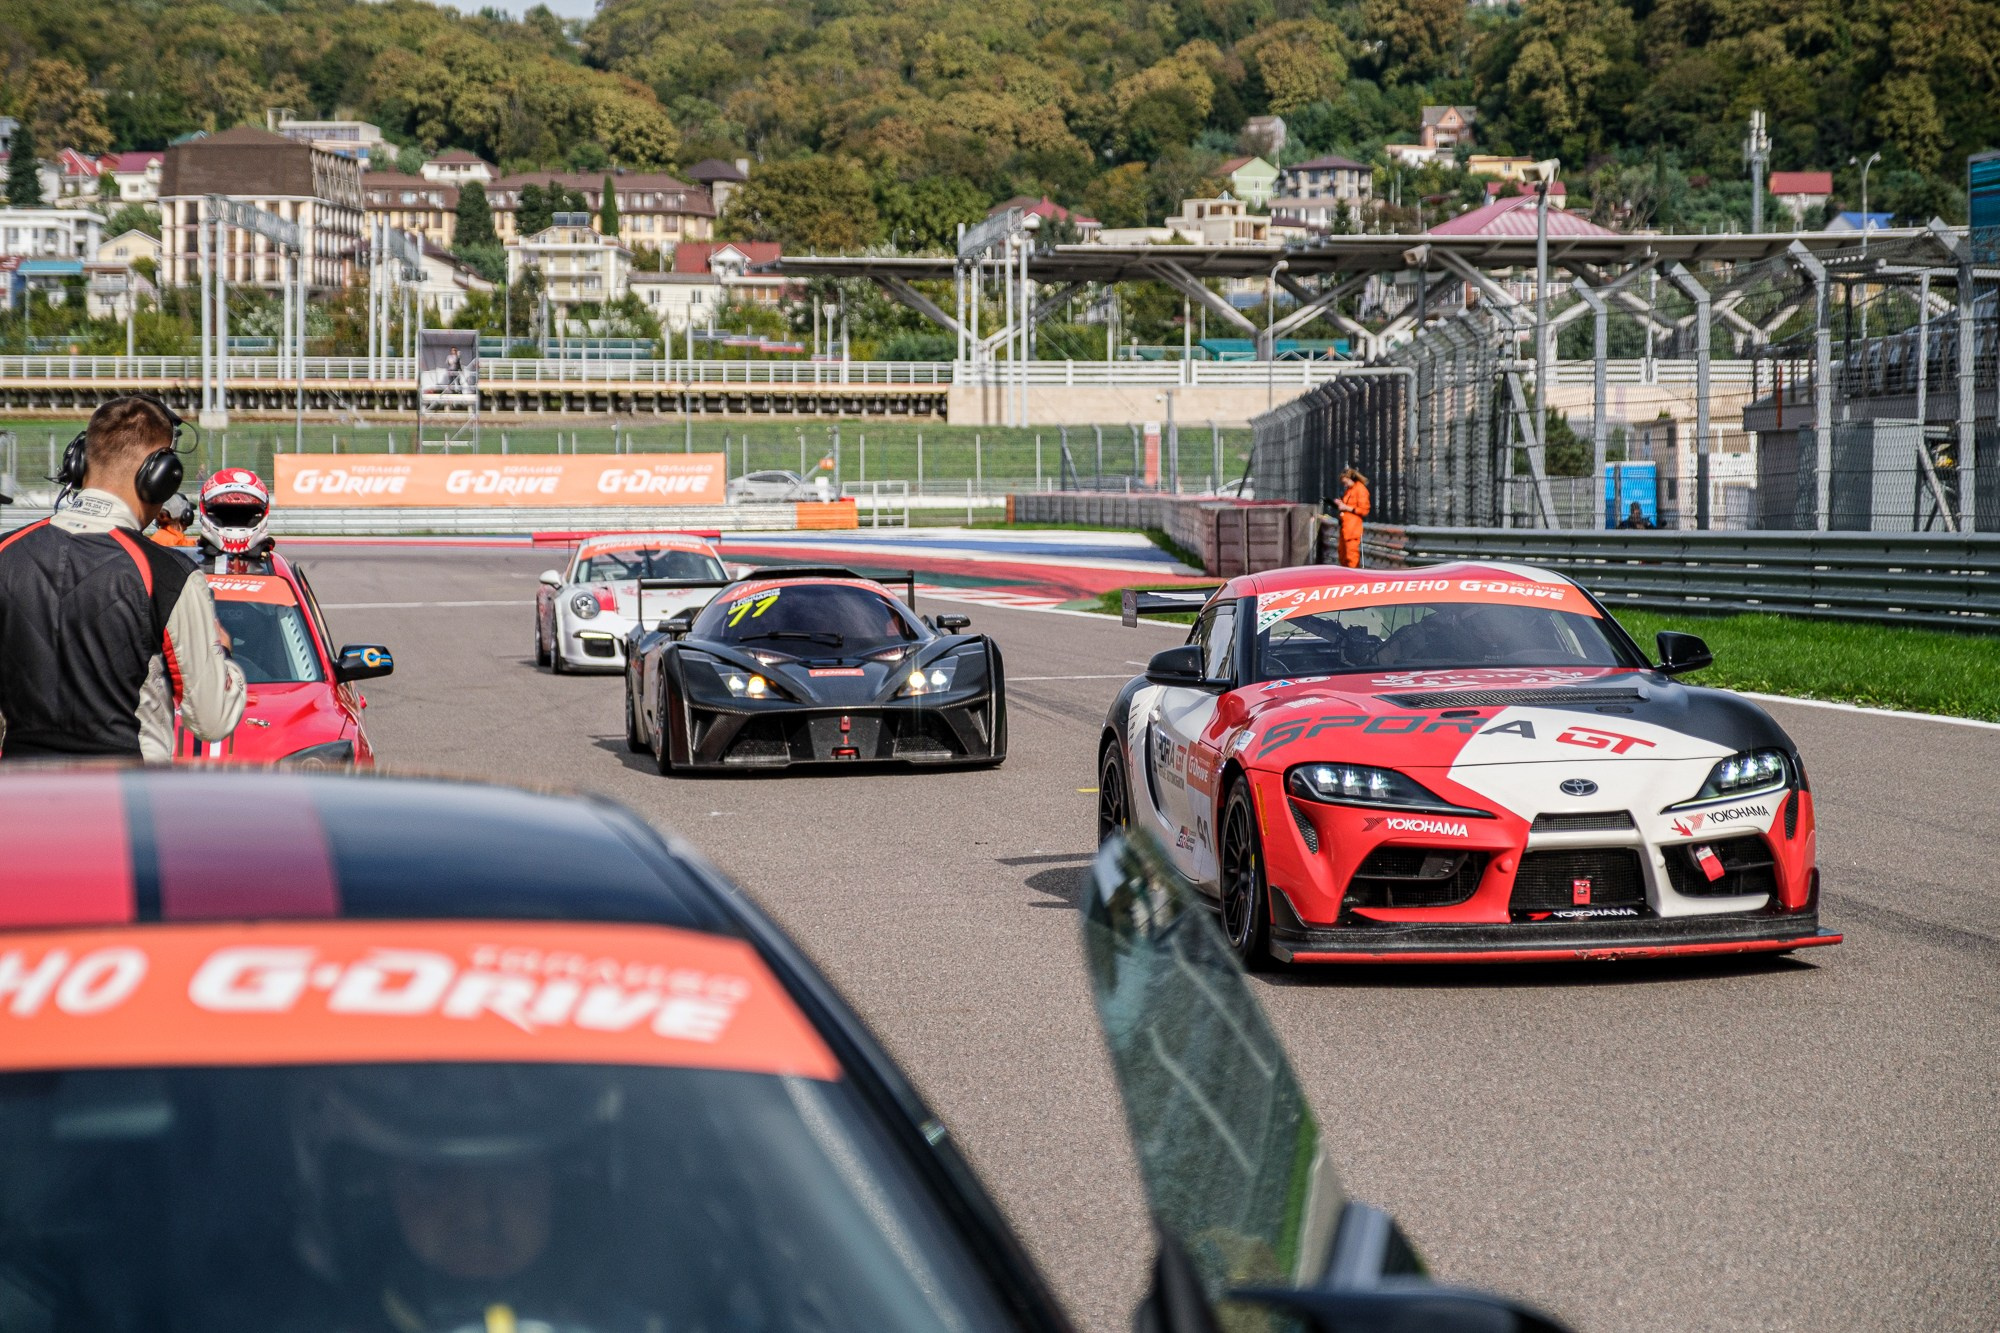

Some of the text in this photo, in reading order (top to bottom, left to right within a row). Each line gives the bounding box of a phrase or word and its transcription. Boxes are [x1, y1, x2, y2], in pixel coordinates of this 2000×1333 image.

[293, 469, 407, 496] G-DRIVE
[351, 465, 411, 475] ТОПЛИВО
[446, 469, 559, 496] G-DRIVE
[597, 469, 711, 496] G-DRIVE
[1291, 580, 1450, 605] ЗАПРАВЛЕНО
[1459, 580, 1565, 600] G-DRIVE
[1511, 581, 1566, 593] ТОПЛИВО
[1257, 716, 1536, 760] SPORA
[1556, 726, 1657, 755] GT
[1707, 805, 1771, 824] YOKOHAMA
[1386, 818, 1469, 838] YOKOHAMA
[1552, 908, 1639, 919] YOKOHAMA
[187, 945, 738, 1043] G-DRIVE
